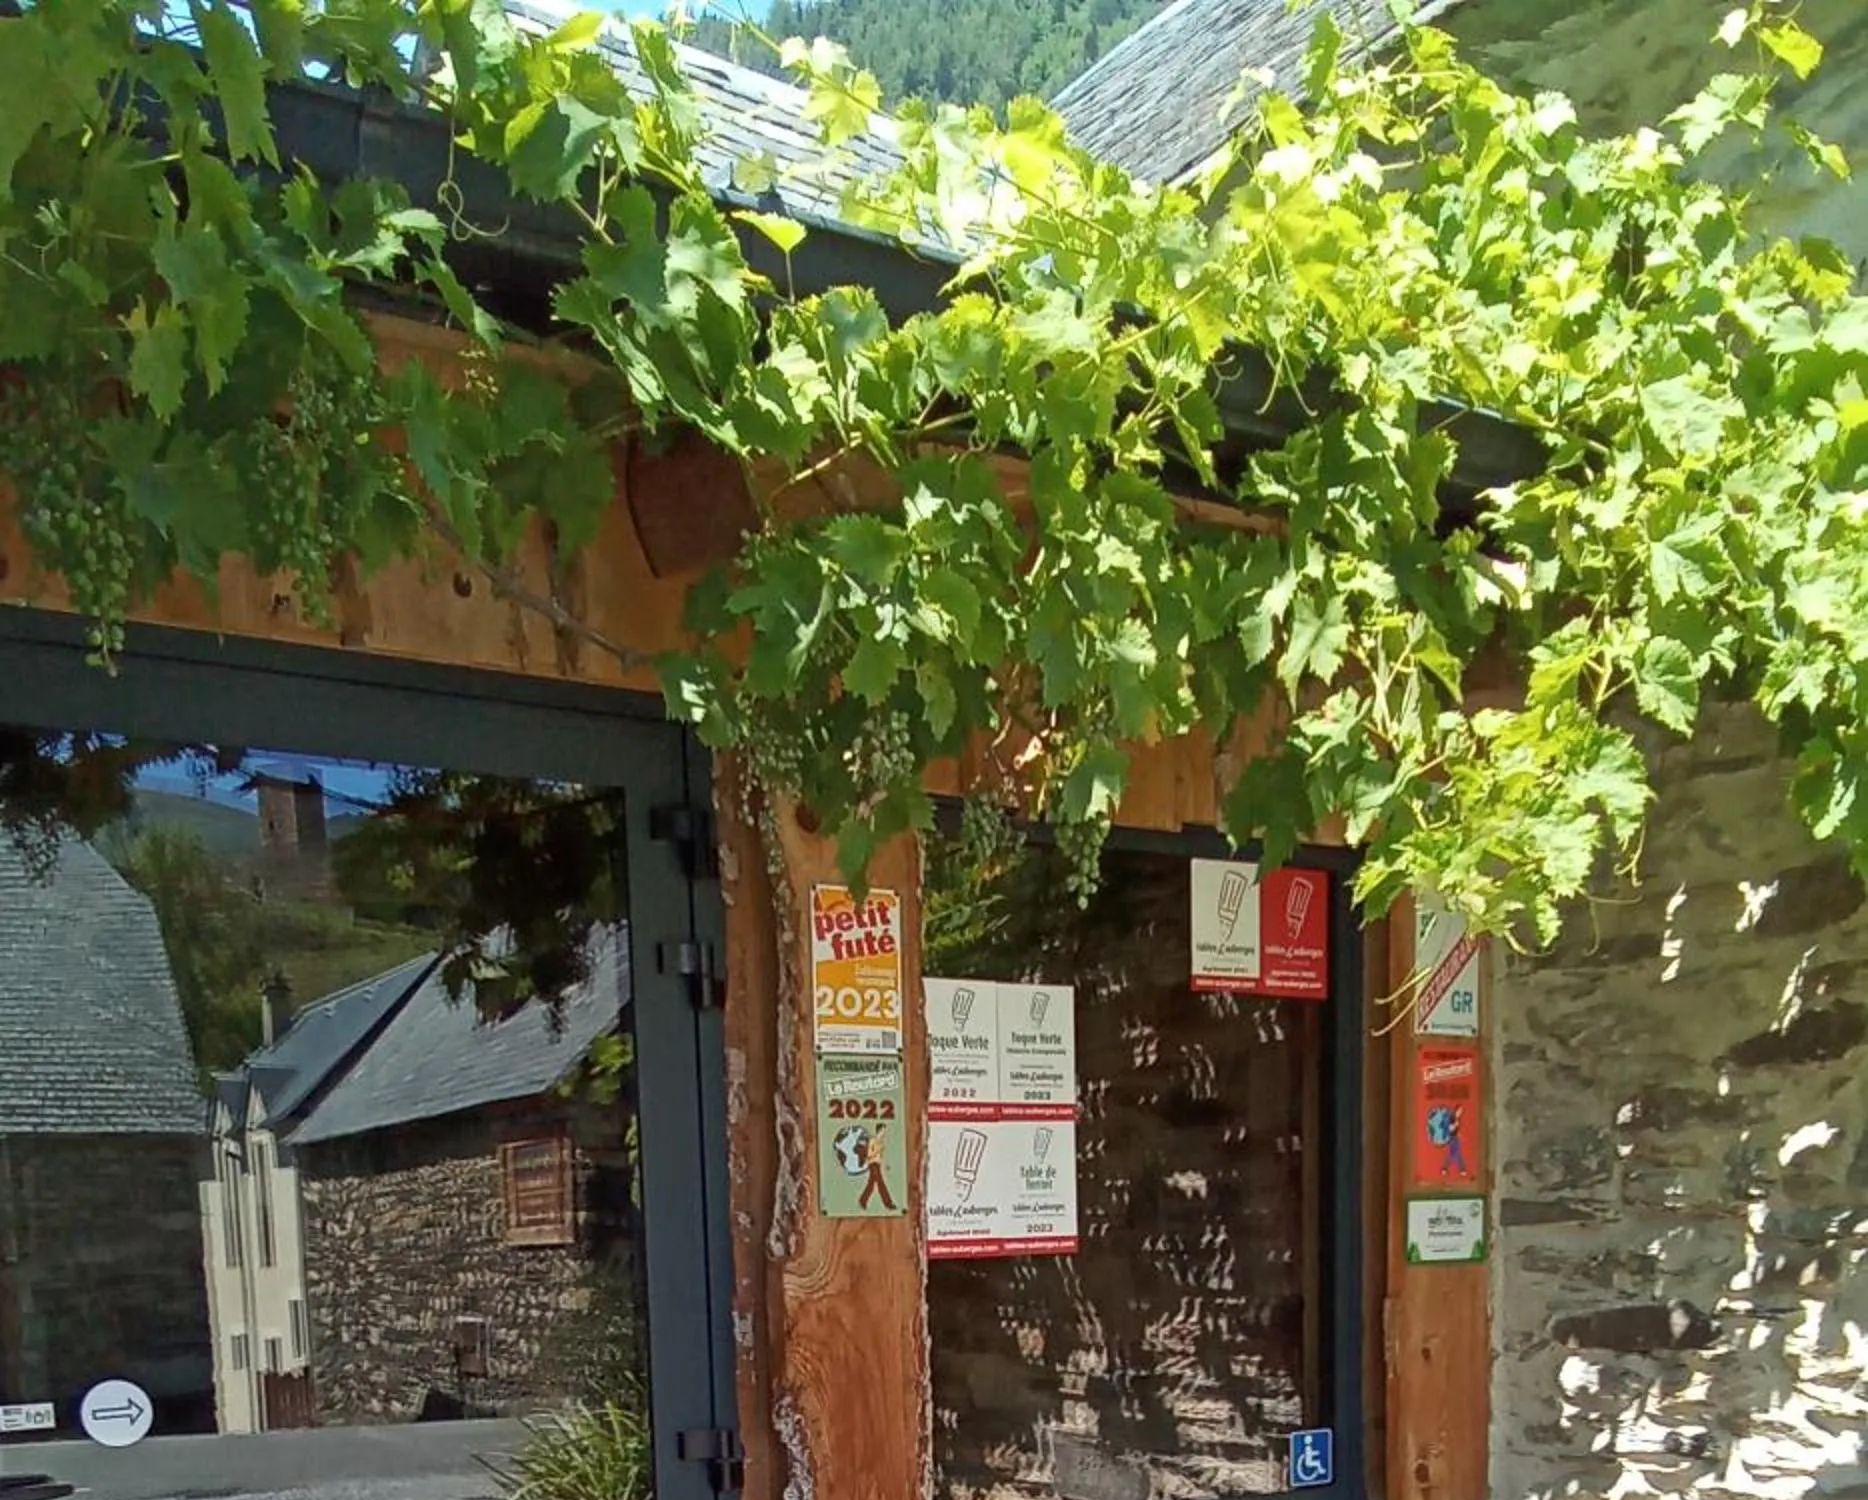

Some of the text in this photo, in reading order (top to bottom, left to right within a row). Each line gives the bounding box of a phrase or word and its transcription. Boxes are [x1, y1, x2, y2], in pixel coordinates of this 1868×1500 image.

[814, 900, 891, 940] petit
[832, 928, 895, 960] futé
[816, 986, 899, 1018] 2023
[1451, 989, 1473, 1013] GR
[962, 1035, 989, 1051] Verte
[943, 1087, 976, 1098] 2022
[829, 1098, 895, 1119] 2022
[1026, 1224, 1053, 1233] 2023
